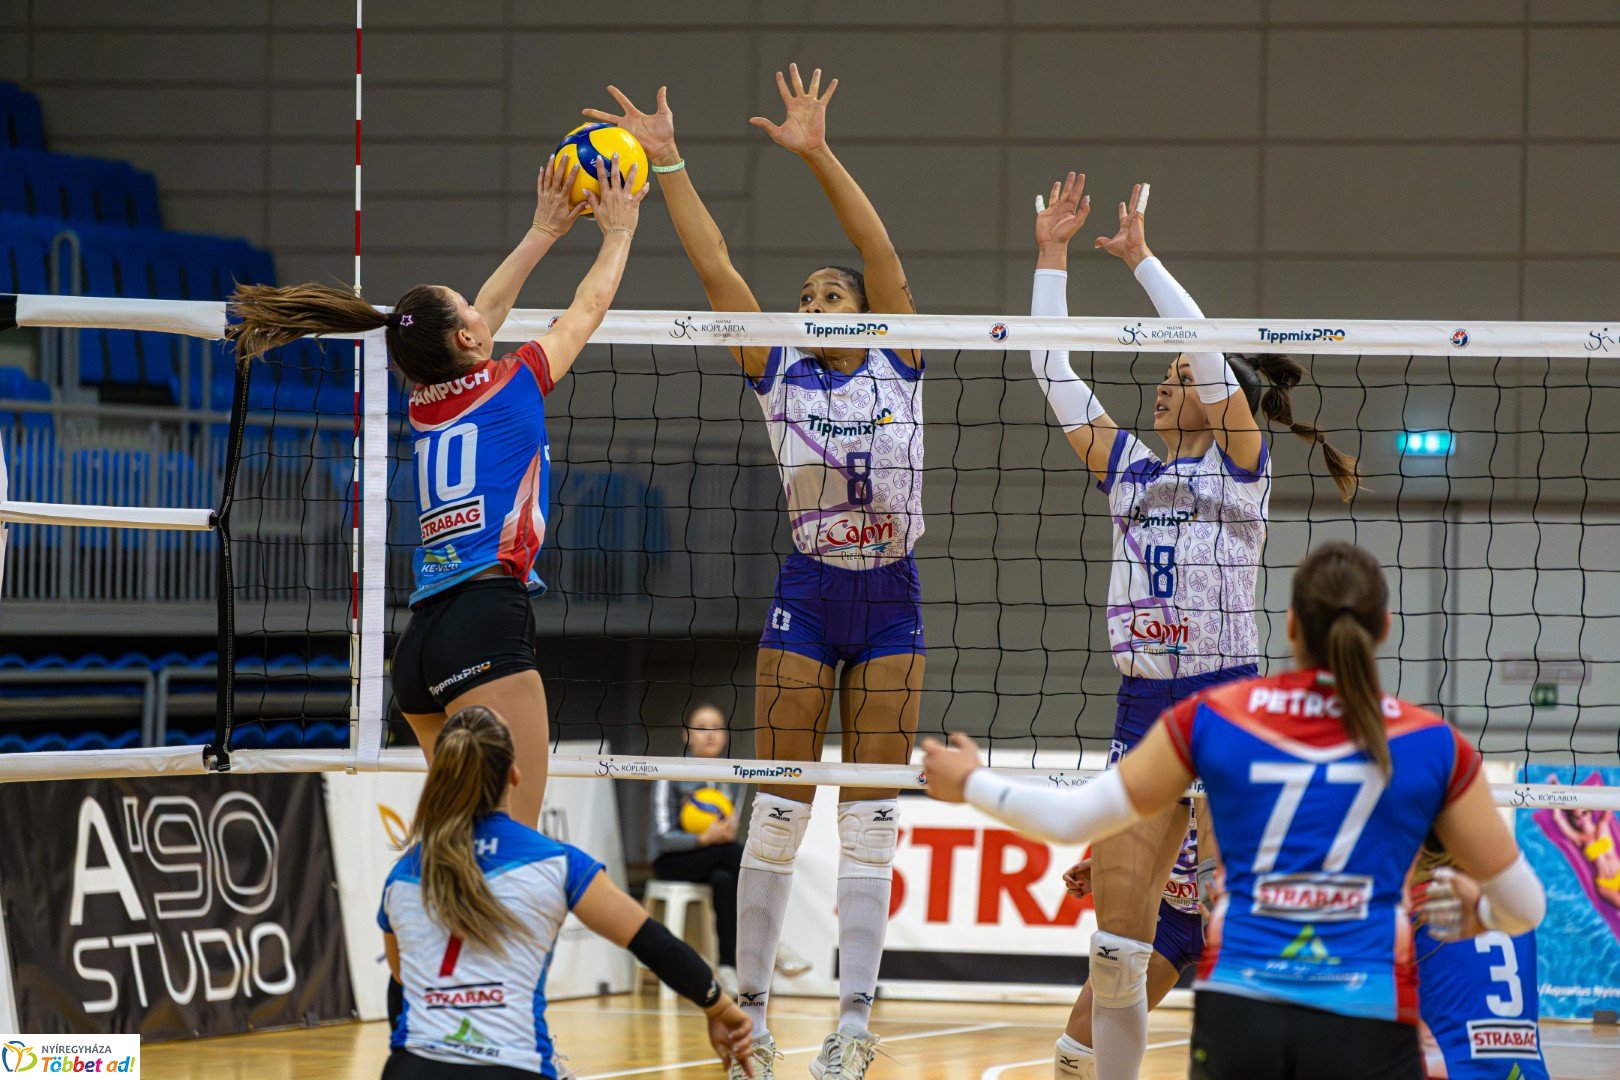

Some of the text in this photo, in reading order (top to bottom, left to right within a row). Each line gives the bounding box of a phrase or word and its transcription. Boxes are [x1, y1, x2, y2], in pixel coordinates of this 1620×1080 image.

[804, 322, 889, 338] TippmixPRO
[1151, 329, 1198, 339] RÖPLABDA
[1257, 327, 1346, 344] TippmixPRO
[414, 422, 478, 512] 10
[846, 451, 873, 505] 8
[826, 514, 893, 549] Capri
[1144, 544, 1175, 598] 18
[733, 765, 803, 779] TippmixPRO
[1249, 762, 1387, 874] 77
[73, 922, 296, 1013] STUDIO
[1475, 930, 1523, 1018] 3
